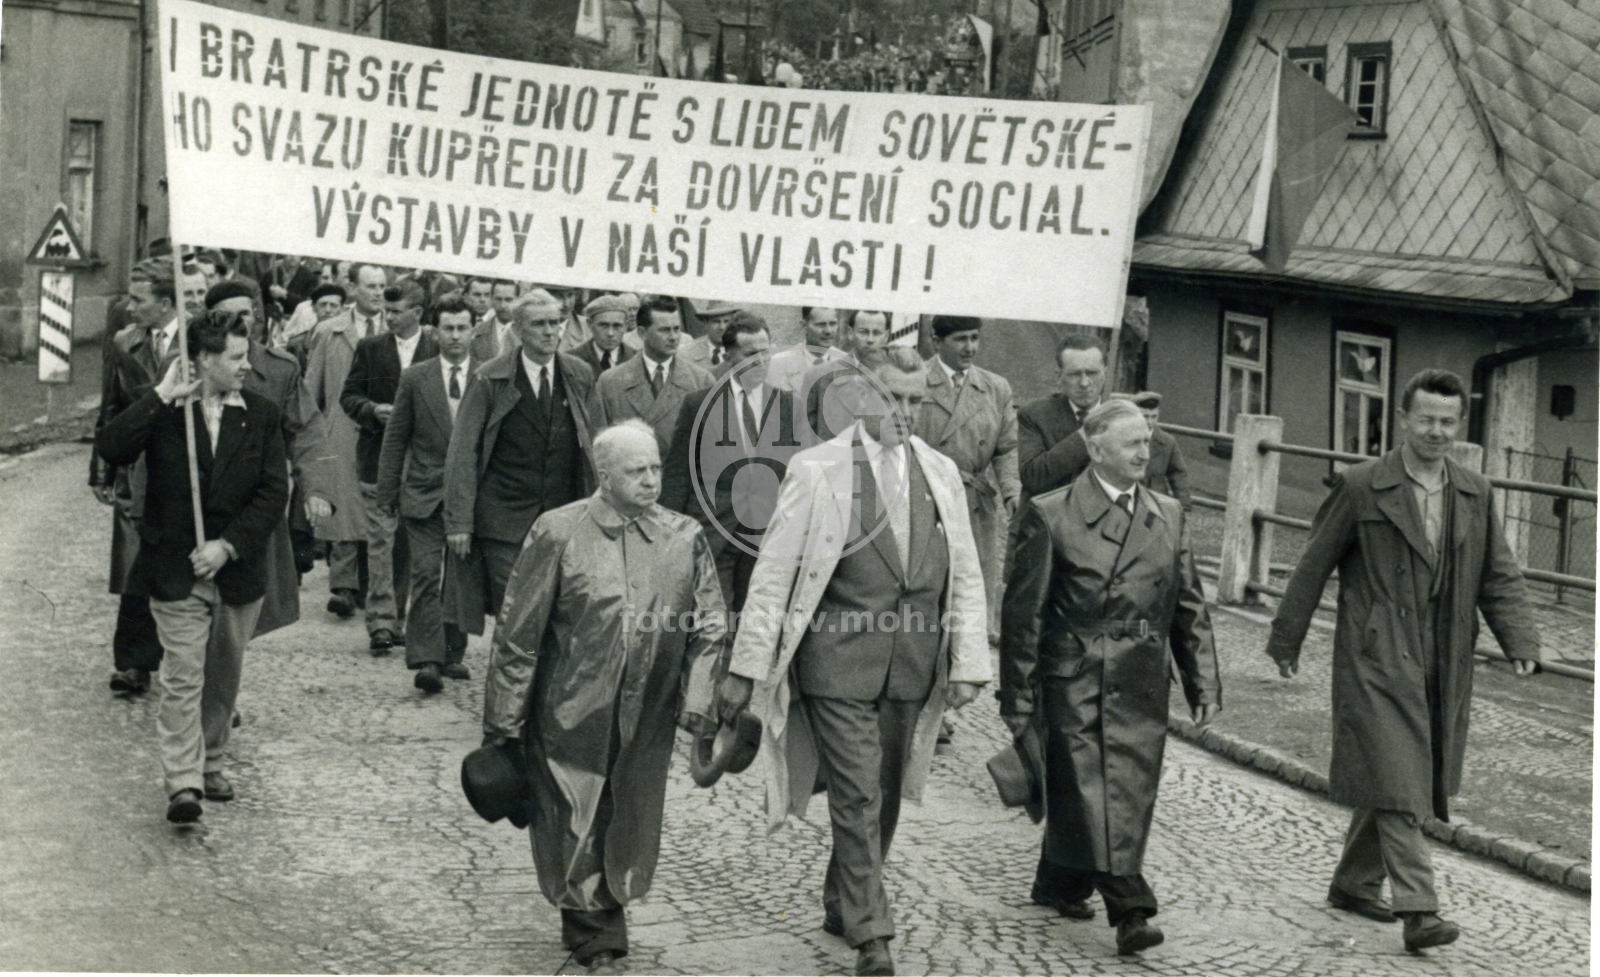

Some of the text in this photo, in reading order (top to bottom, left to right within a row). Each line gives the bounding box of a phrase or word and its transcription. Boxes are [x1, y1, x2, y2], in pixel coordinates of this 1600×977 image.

[200, 22, 444, 112] BRATRSKÉ
[672, 96, 699, 144] S
[710, 98, 850, 153] LIDEM
[233, 103, 367, 169] SVAZU
[387, 122, 587, 195] KUPŘEDU
[607, 153, 658, 206] ZA
[685, 158, 903, 225] DOVRŠENÍ
[928, 179, 1109, 236] SOCIAL.
[313, 181, 533, 263] VÝSTAVBY
[561, 216, 583, 267] V
[607, 214, 711, 277] NAŠÍ
